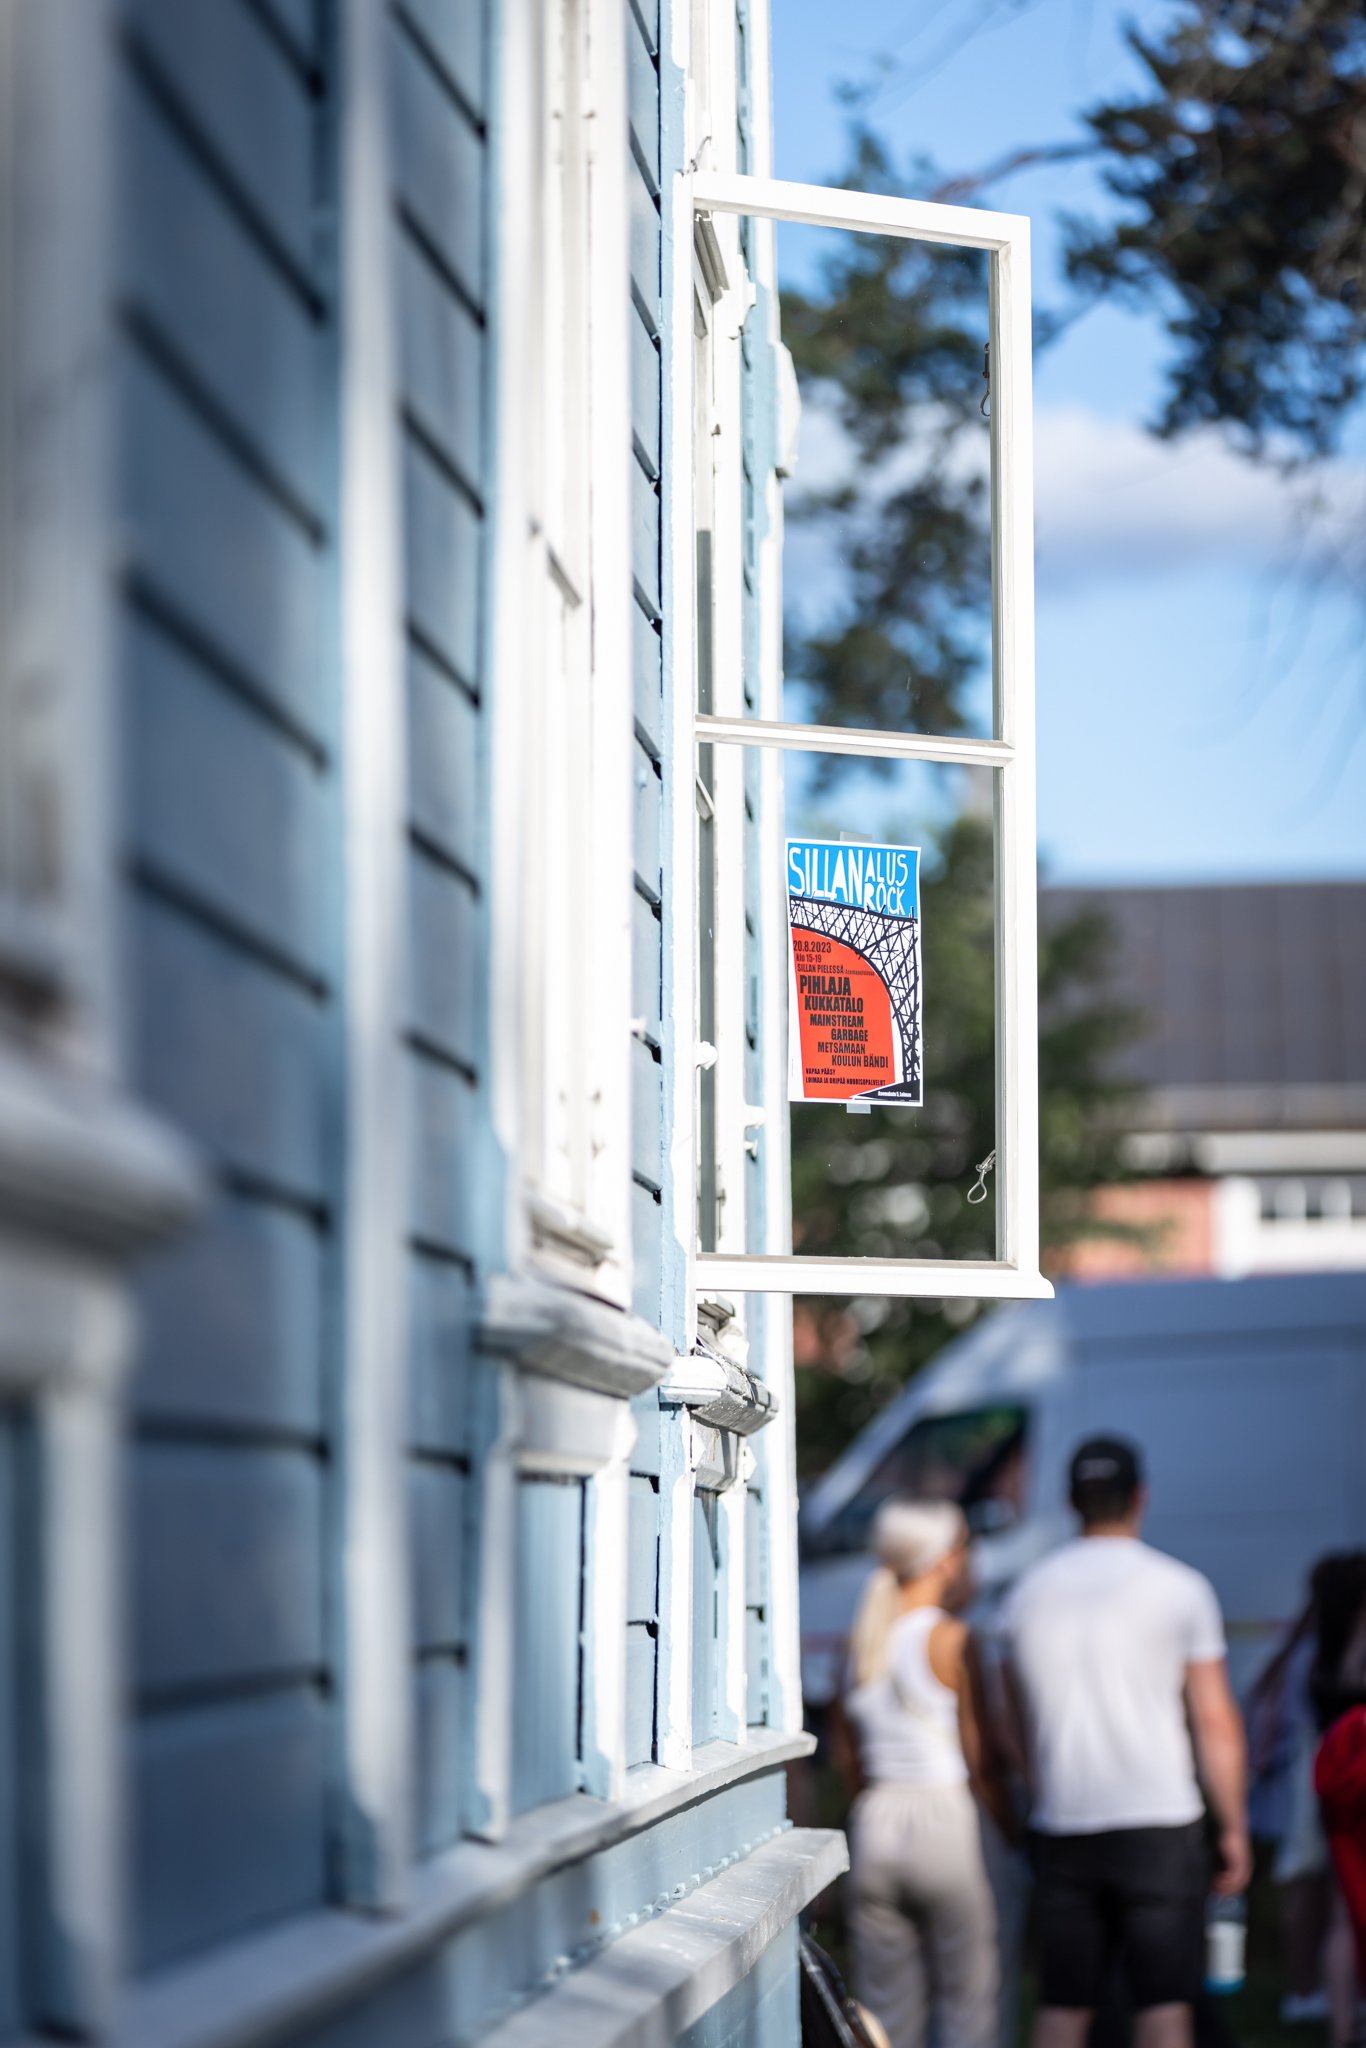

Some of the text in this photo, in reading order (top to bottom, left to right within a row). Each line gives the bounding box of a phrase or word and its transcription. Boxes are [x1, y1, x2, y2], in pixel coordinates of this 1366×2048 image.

[863, 882, 906, 915] ROCK
[793, 940, 832, 953] 20.8.2023
[806, 953, 822, 963] 15-19
[800, 975, 851, 995] PIHLAJA
[804, 996, 864, 1013] KUKKATALO
[810, 1014, 864, 1028] MAINSTREAM
[831, 1028, 868, 1042] GARBAGE
[832, 1053, 889, 1068] KOULUN BÄNDI
